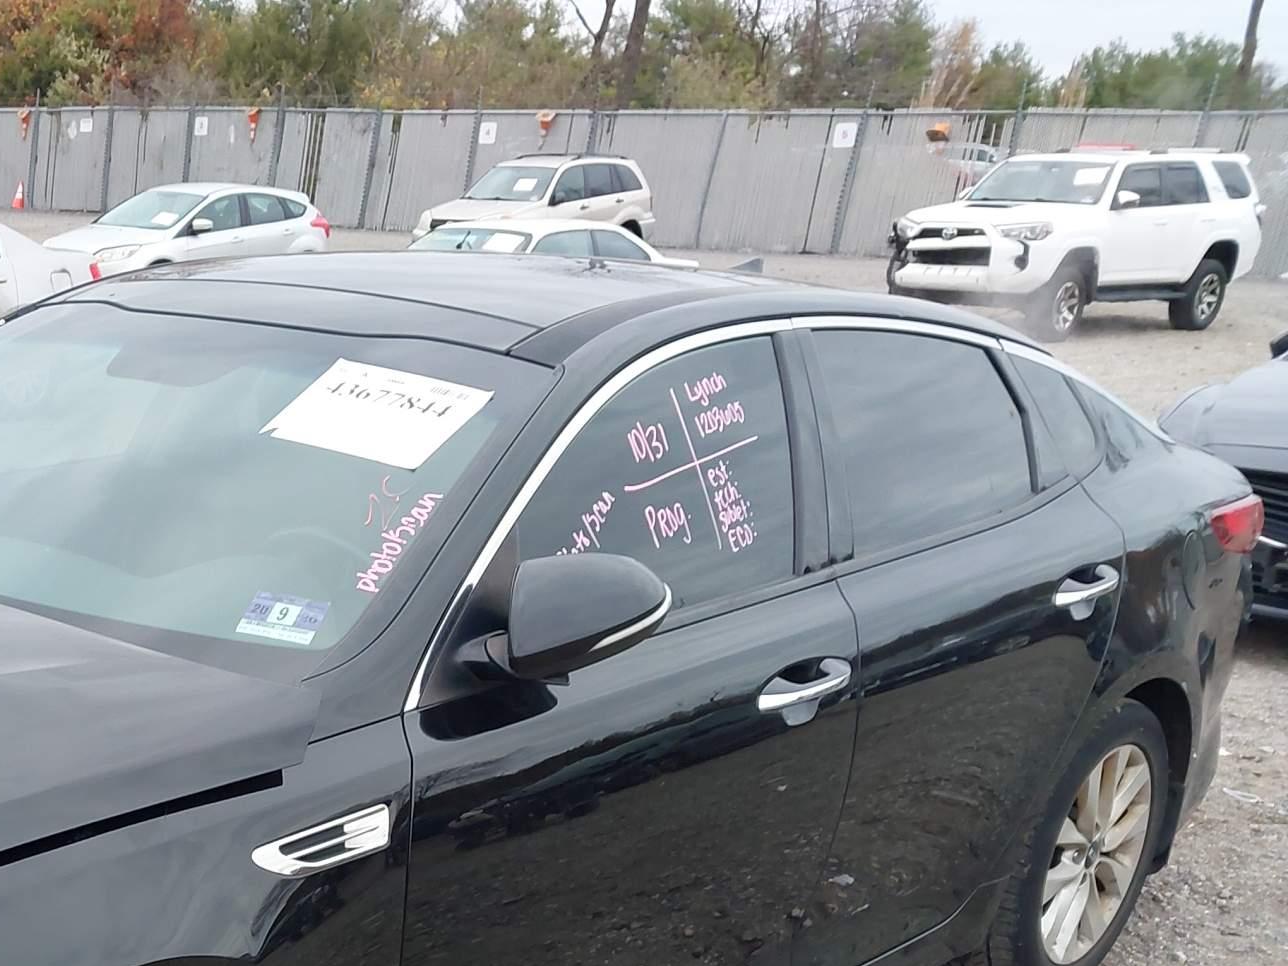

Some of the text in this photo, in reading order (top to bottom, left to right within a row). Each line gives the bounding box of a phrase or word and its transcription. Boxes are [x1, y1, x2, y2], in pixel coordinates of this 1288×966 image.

[326, 381, 453, 418] 43677844
[684, 371, 727, 406] Lynch
[627, 421, 669, 463] 10/31
[276, 606, 289, 621] 9
